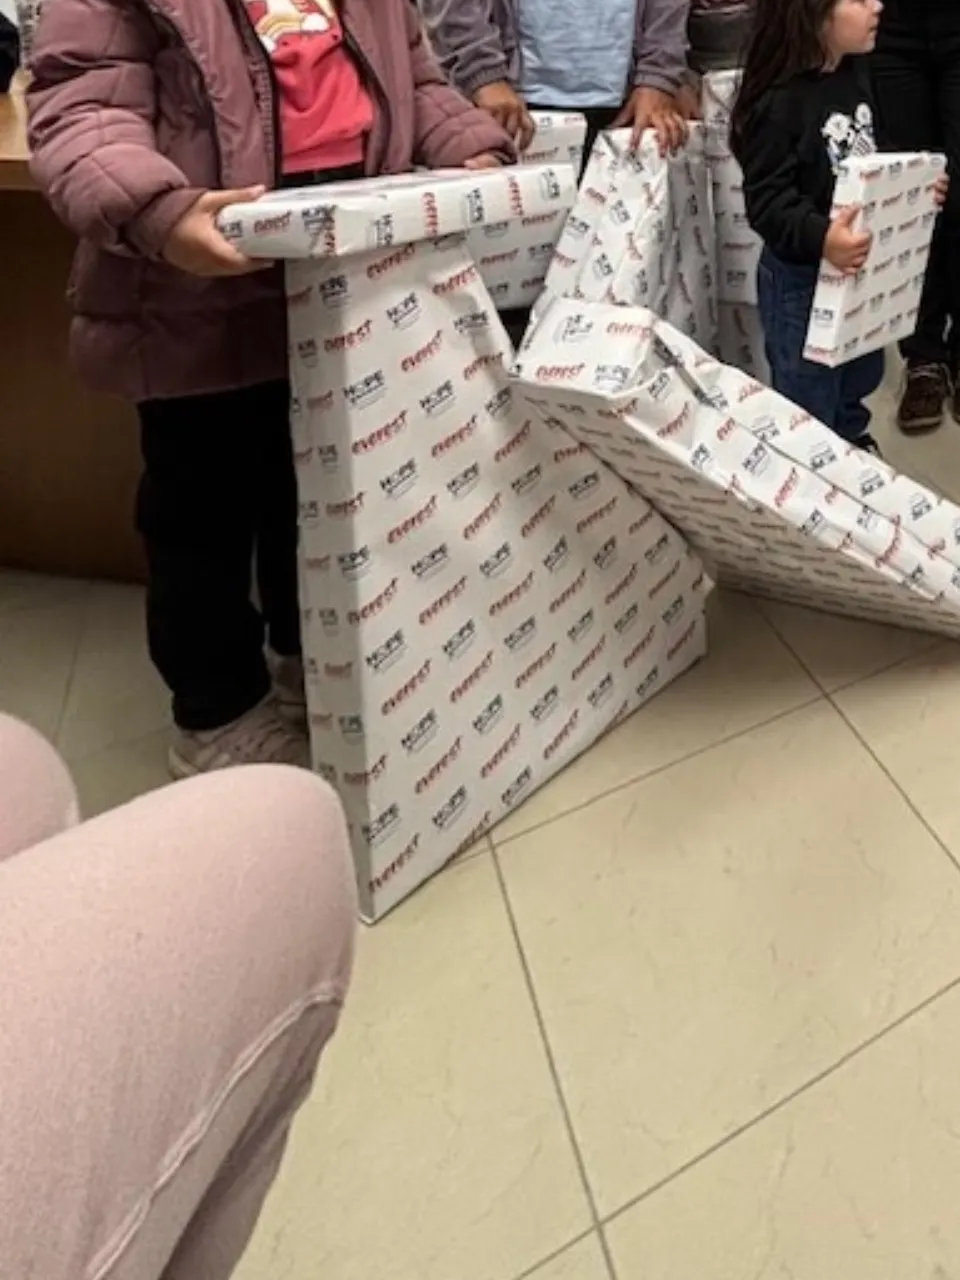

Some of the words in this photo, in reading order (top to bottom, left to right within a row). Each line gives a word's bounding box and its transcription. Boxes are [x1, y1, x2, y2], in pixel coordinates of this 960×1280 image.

[352, 410, 406, 455] everest
[388, 495, 436, 544] everest
[380, 657, 431, 716] everest
[415, 735, 462, 795] everest
